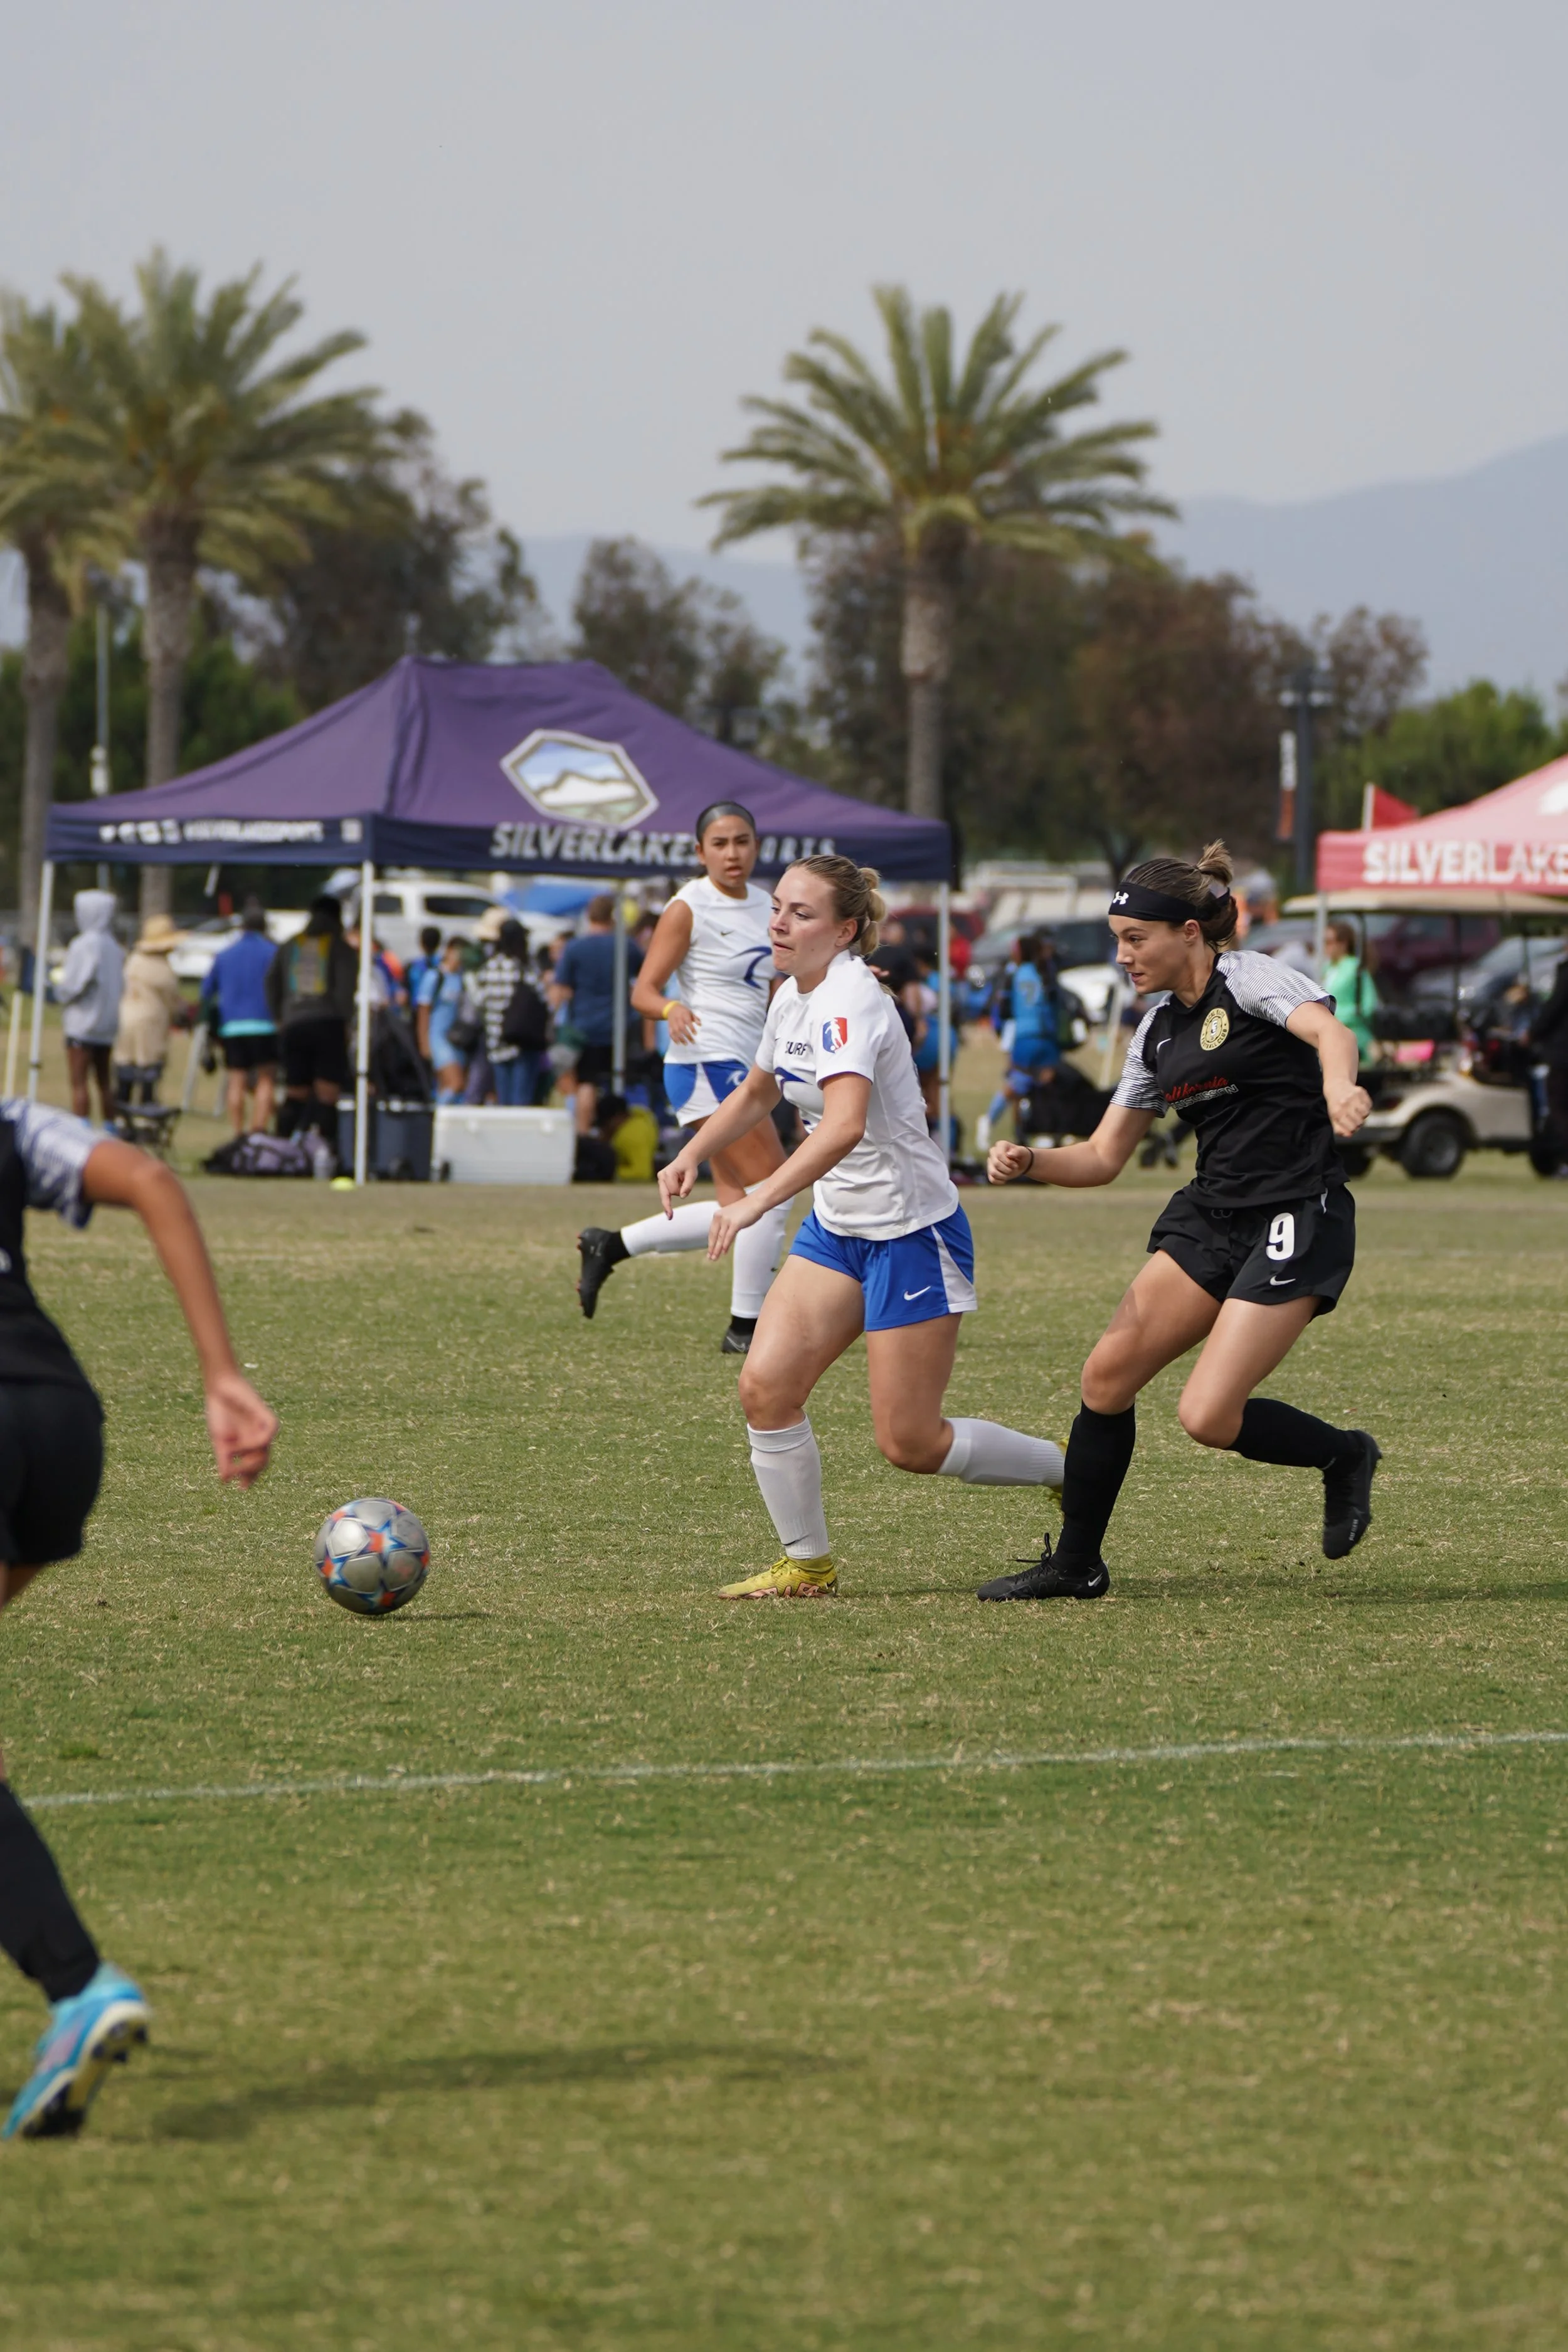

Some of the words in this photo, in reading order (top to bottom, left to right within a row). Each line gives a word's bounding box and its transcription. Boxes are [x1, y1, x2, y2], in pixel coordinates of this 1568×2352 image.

[760, 835, 835, 864] ORTS
[1217, 1029, 1227, 1044] CLUB
[1266, 1212, 1295, 1261] 9
